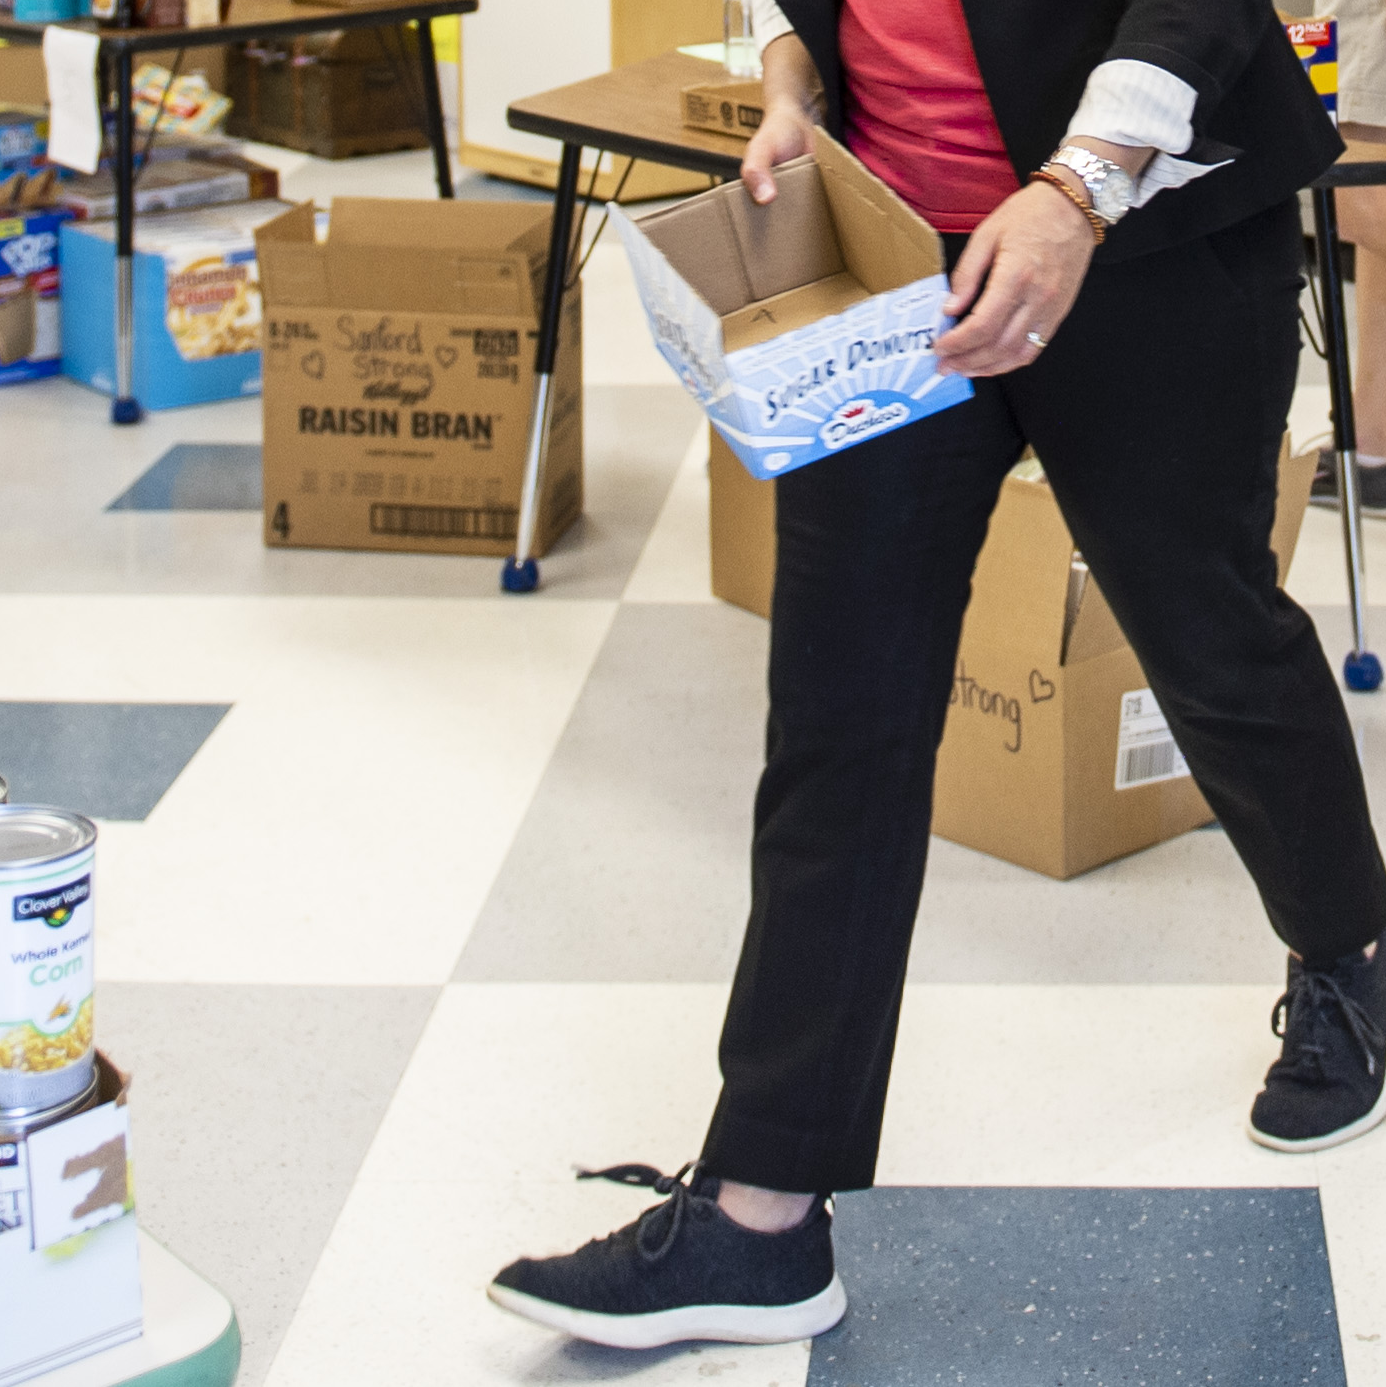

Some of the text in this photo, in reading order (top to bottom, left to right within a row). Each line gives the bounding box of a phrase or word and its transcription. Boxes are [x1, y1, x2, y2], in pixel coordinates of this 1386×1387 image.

[1287, 23, 1305, 43] 12
[299, 405, 493, 442] RAISIN BRAN
[271, 499, 291, 540] 4
[18, 893, 63, 915] Clover
[11, 945, 59, 965] Whole
[29, 955, 83, 987] Corn
